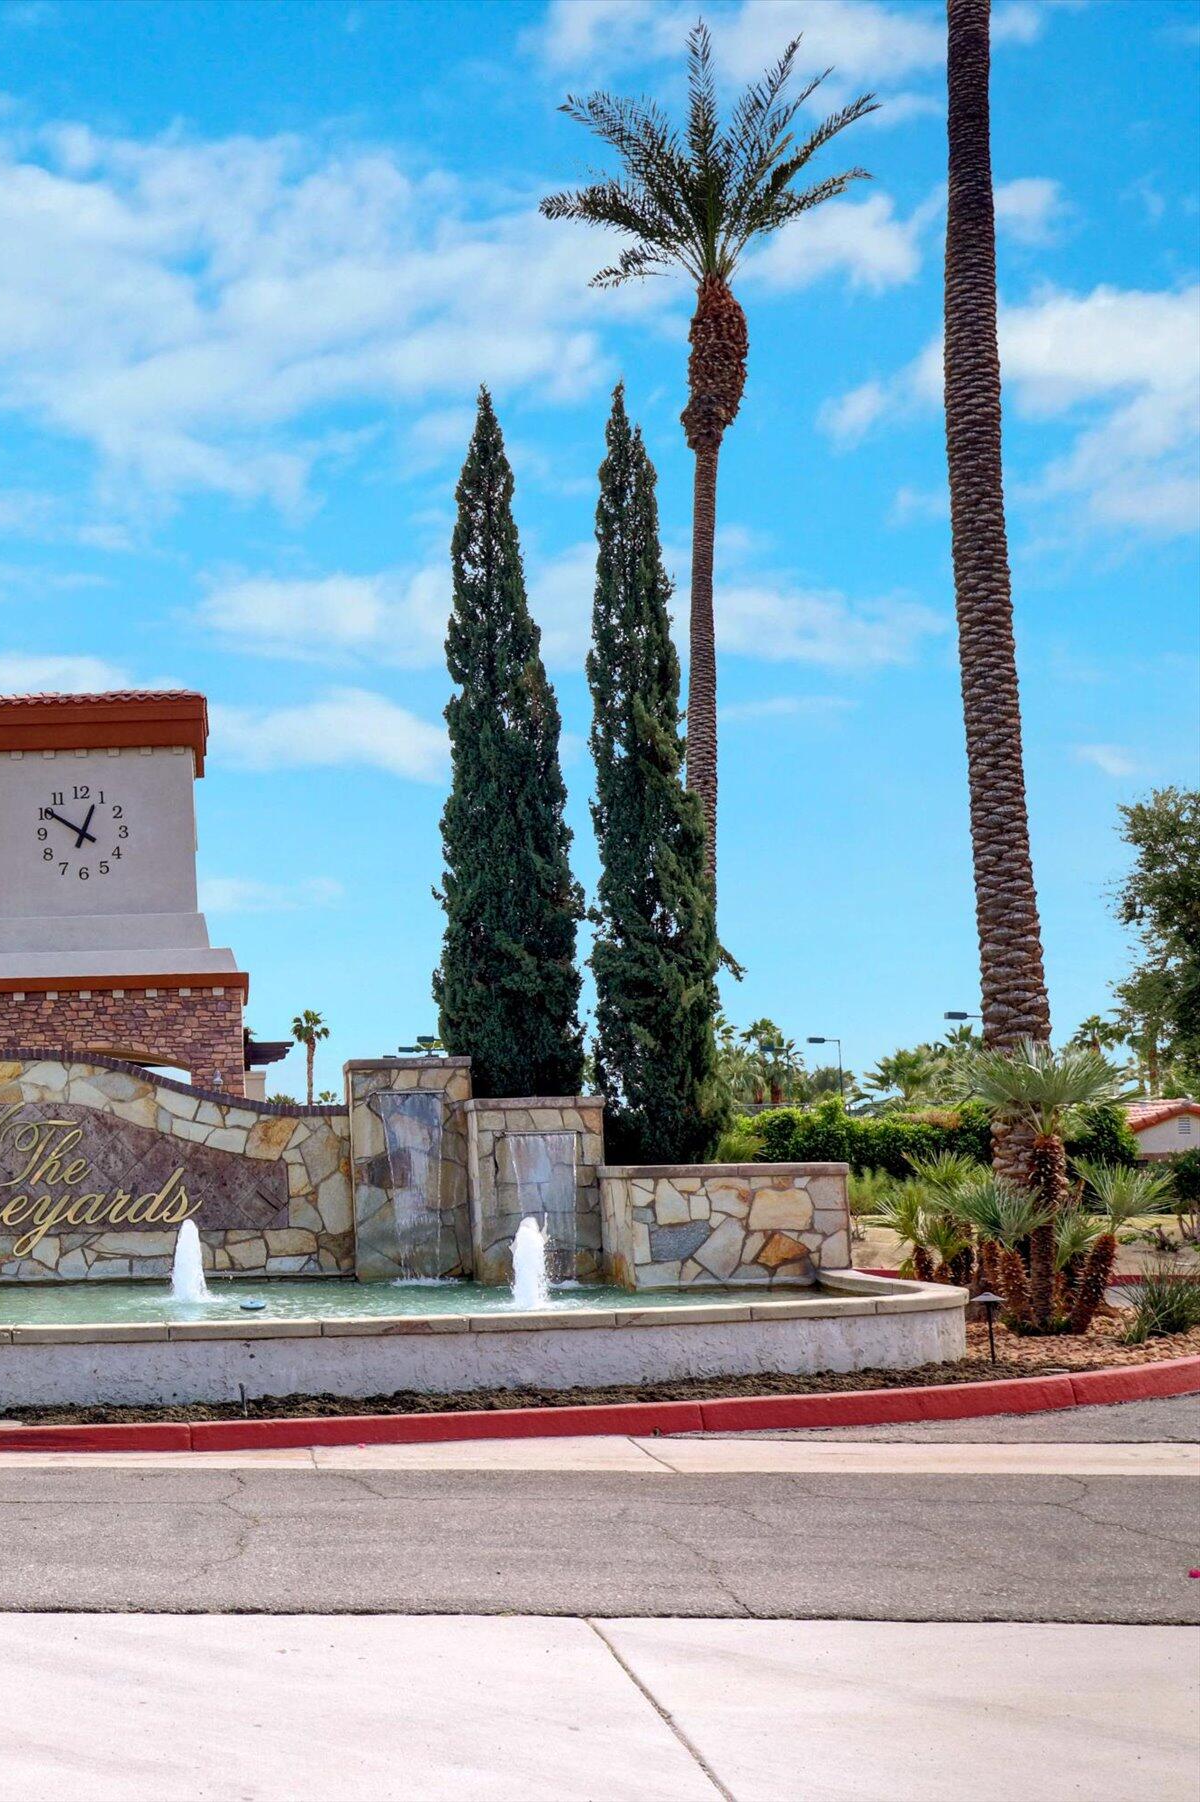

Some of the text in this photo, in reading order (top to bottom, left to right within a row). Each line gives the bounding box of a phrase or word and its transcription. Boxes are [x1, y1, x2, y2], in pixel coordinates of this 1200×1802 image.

[51, 791, 65, 806] 11
[73, 785, 90, 800] 12
[99, 790, 106, 805] 1
[38, 807, 54, 821] 10
[112, 805, 123, 819] 2
[37, 827, 48, 841] 9
[118, 825, 129, 839] 3
[43, 847, 54, 861] 8
[111, 846, 123, 860] 4
[59, 862, 69, 876] 7
[79, 866, 90, 880] 6
[99, 860, 110, 875] 5
